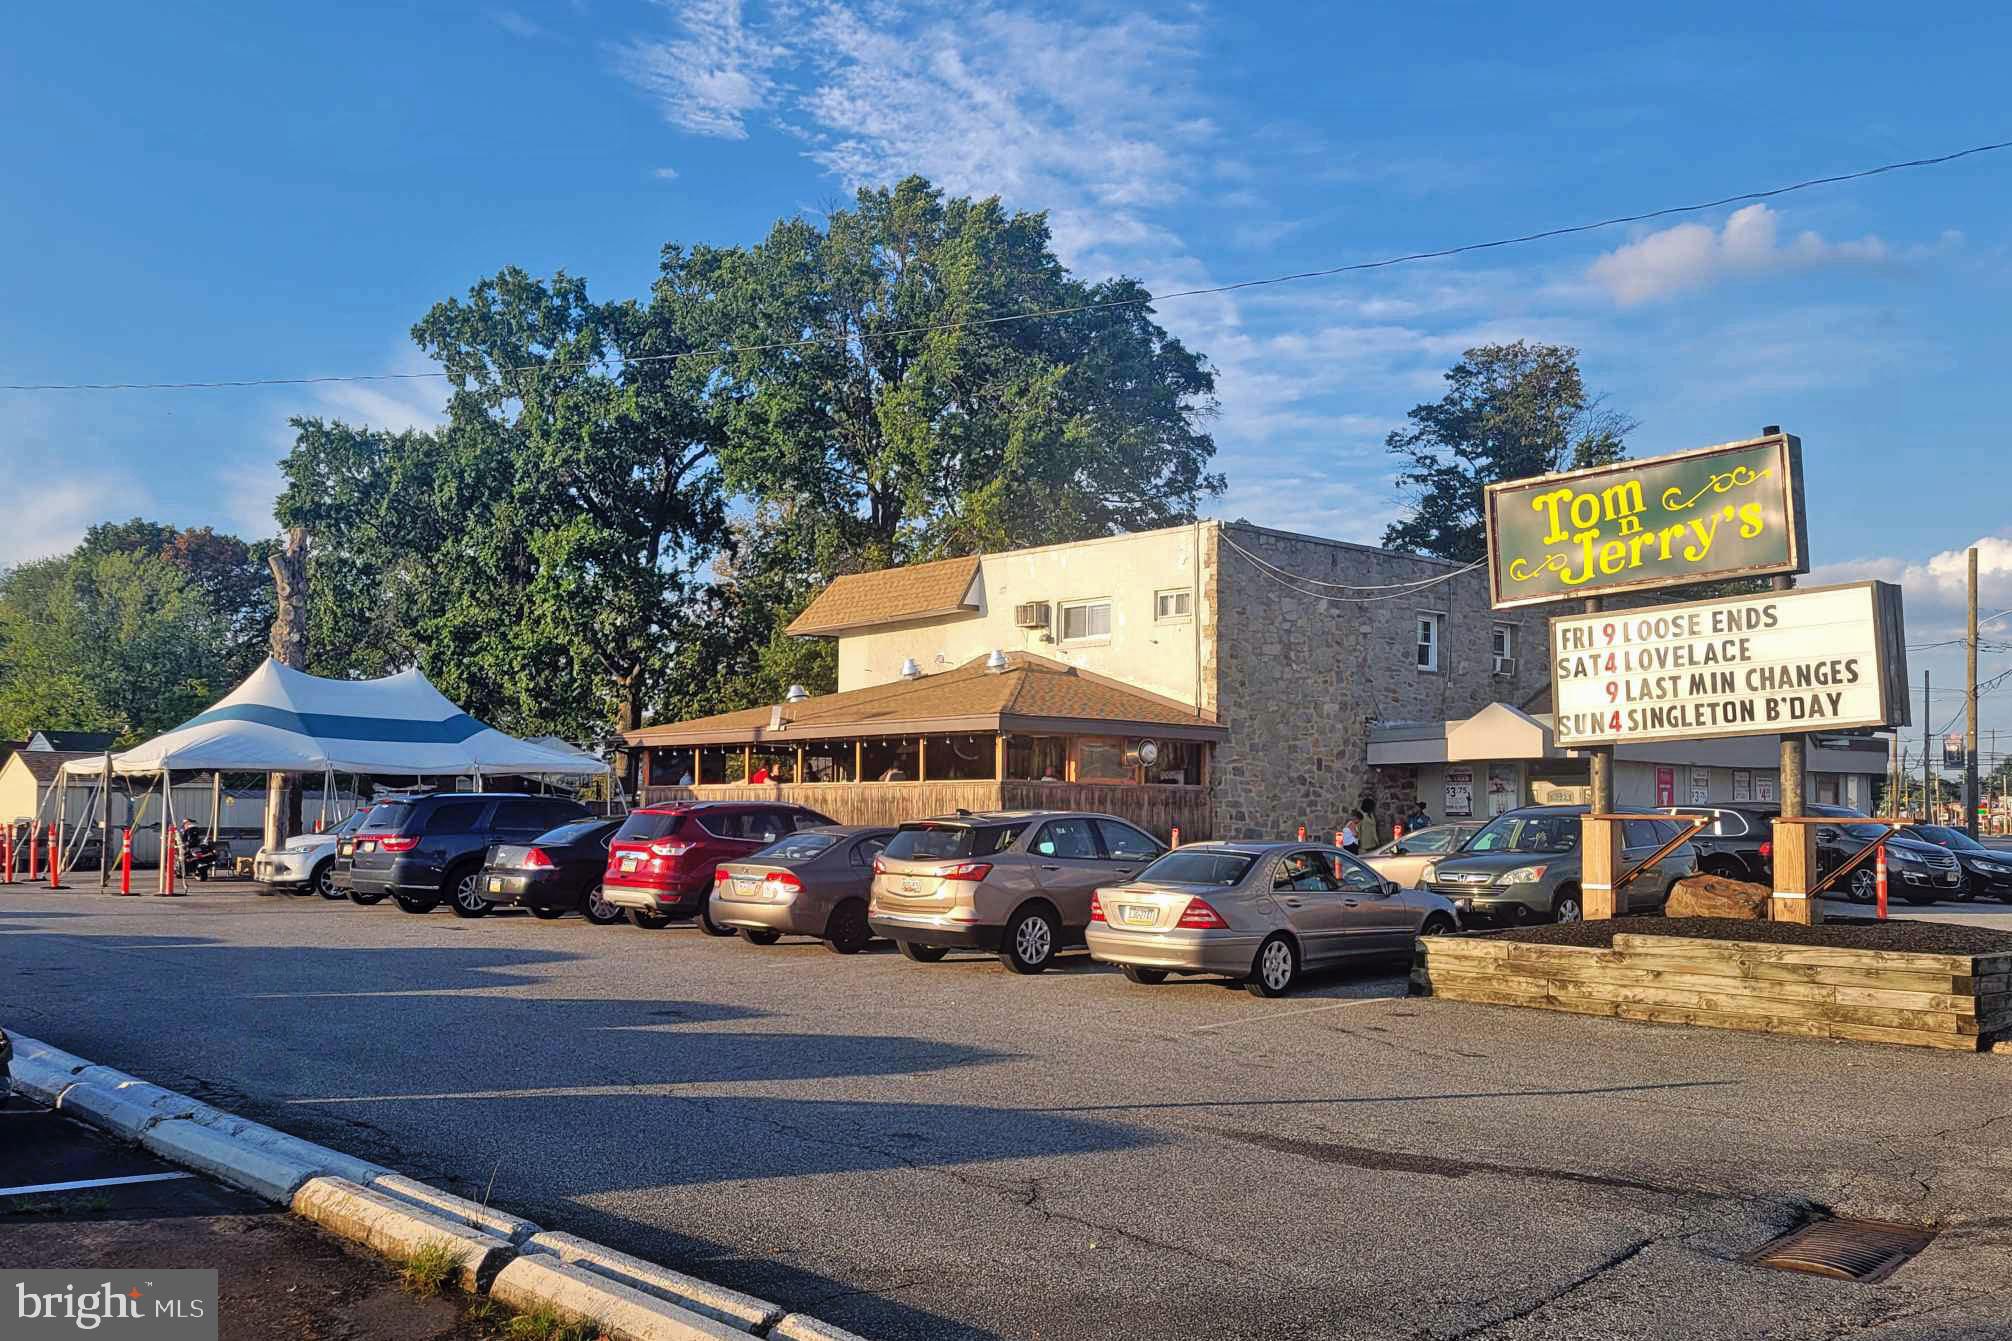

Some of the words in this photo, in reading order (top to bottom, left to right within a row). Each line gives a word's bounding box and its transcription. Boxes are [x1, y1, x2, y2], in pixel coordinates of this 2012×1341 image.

[1532, 479, 1647, 545] Tom
[1618, 515, 1643, 536] n
[1559, 502, 1764, 585] Jerry's
[1561, 625, 1594, 650] FRI
[1602, 623, 1616, 645] 9
[1623, 614, 1701, 643] LOOSE
[1712, 604, 1778, 633] ENDS
[1558, 654, 1601, 679] SAT
[1604, 652, 1617, 673] 4
[1624, 638, 1752, 672] LOVELACE
[1606, 681, 1618, 703] 9
[1625, 675, 1681, 702] LAST
[1689, 671, 1735, 696] MIN
[1745, 659, 1859, 691] CHANGES
[1559, 711, 1605, 736] SUN
[1608, 710, 1622, 732] 4
[1627, 699, 1755, 732] SINGLETON
[1766, 692, 1842, 721] B'DAY
